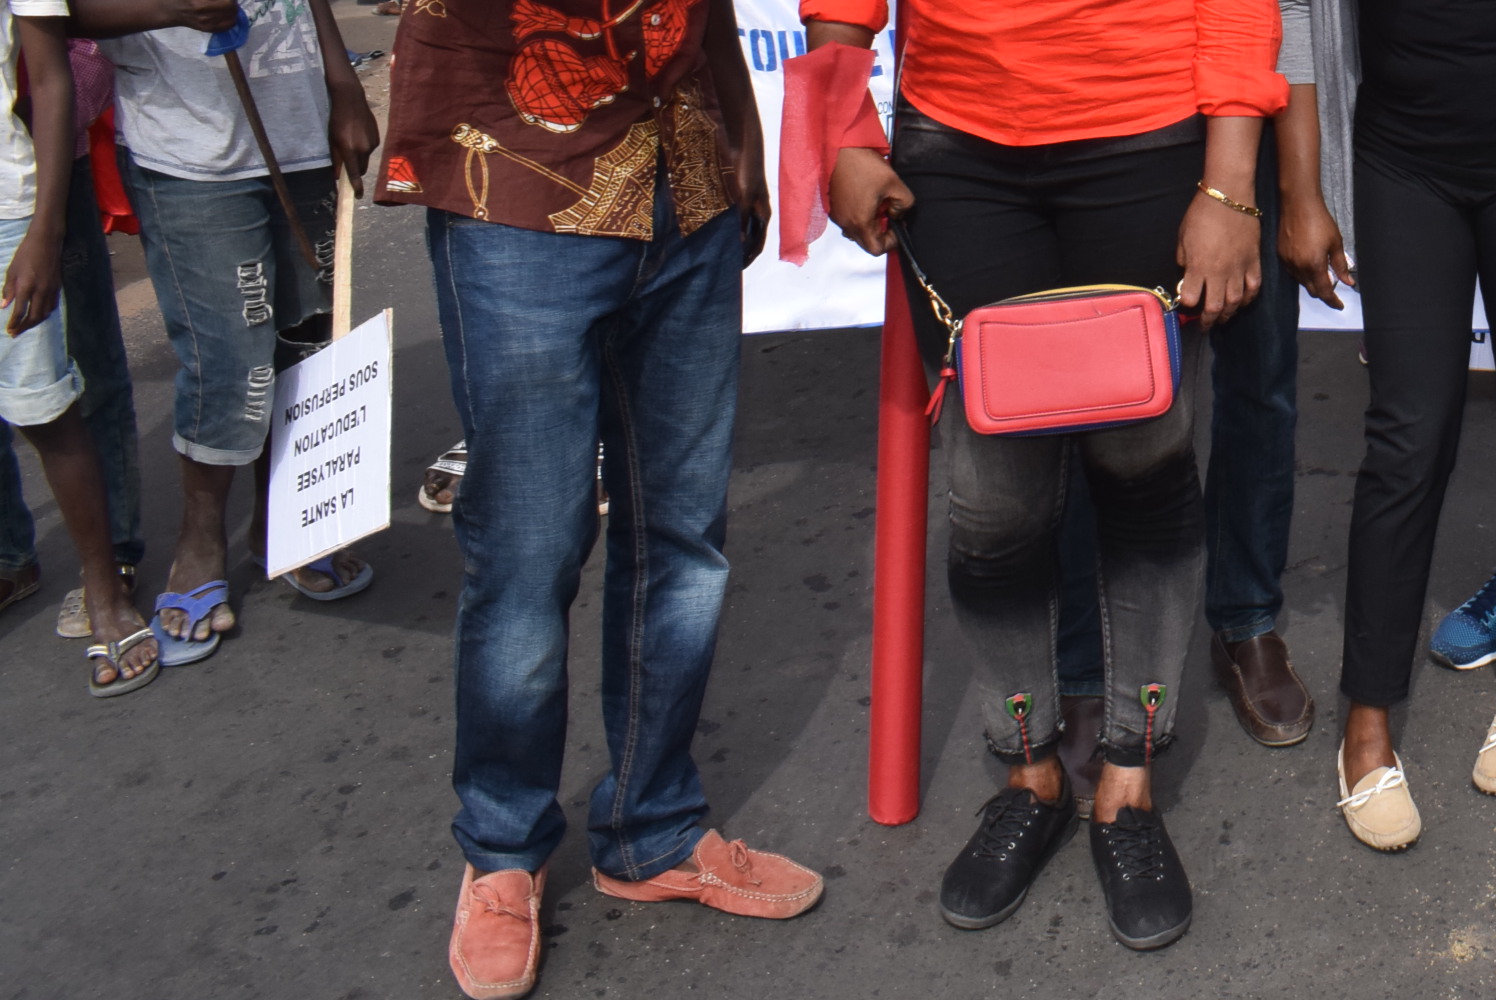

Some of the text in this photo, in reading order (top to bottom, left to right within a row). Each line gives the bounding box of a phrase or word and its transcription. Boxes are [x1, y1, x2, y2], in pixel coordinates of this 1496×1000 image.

[284, 361, 378, 425] SOUS PERFUSION
[294, 405, 367, 457] L'EDUCATION
[297, 446, 360, 492] PARALYSEE
[301, 488, 354, 527] LA SANTE
